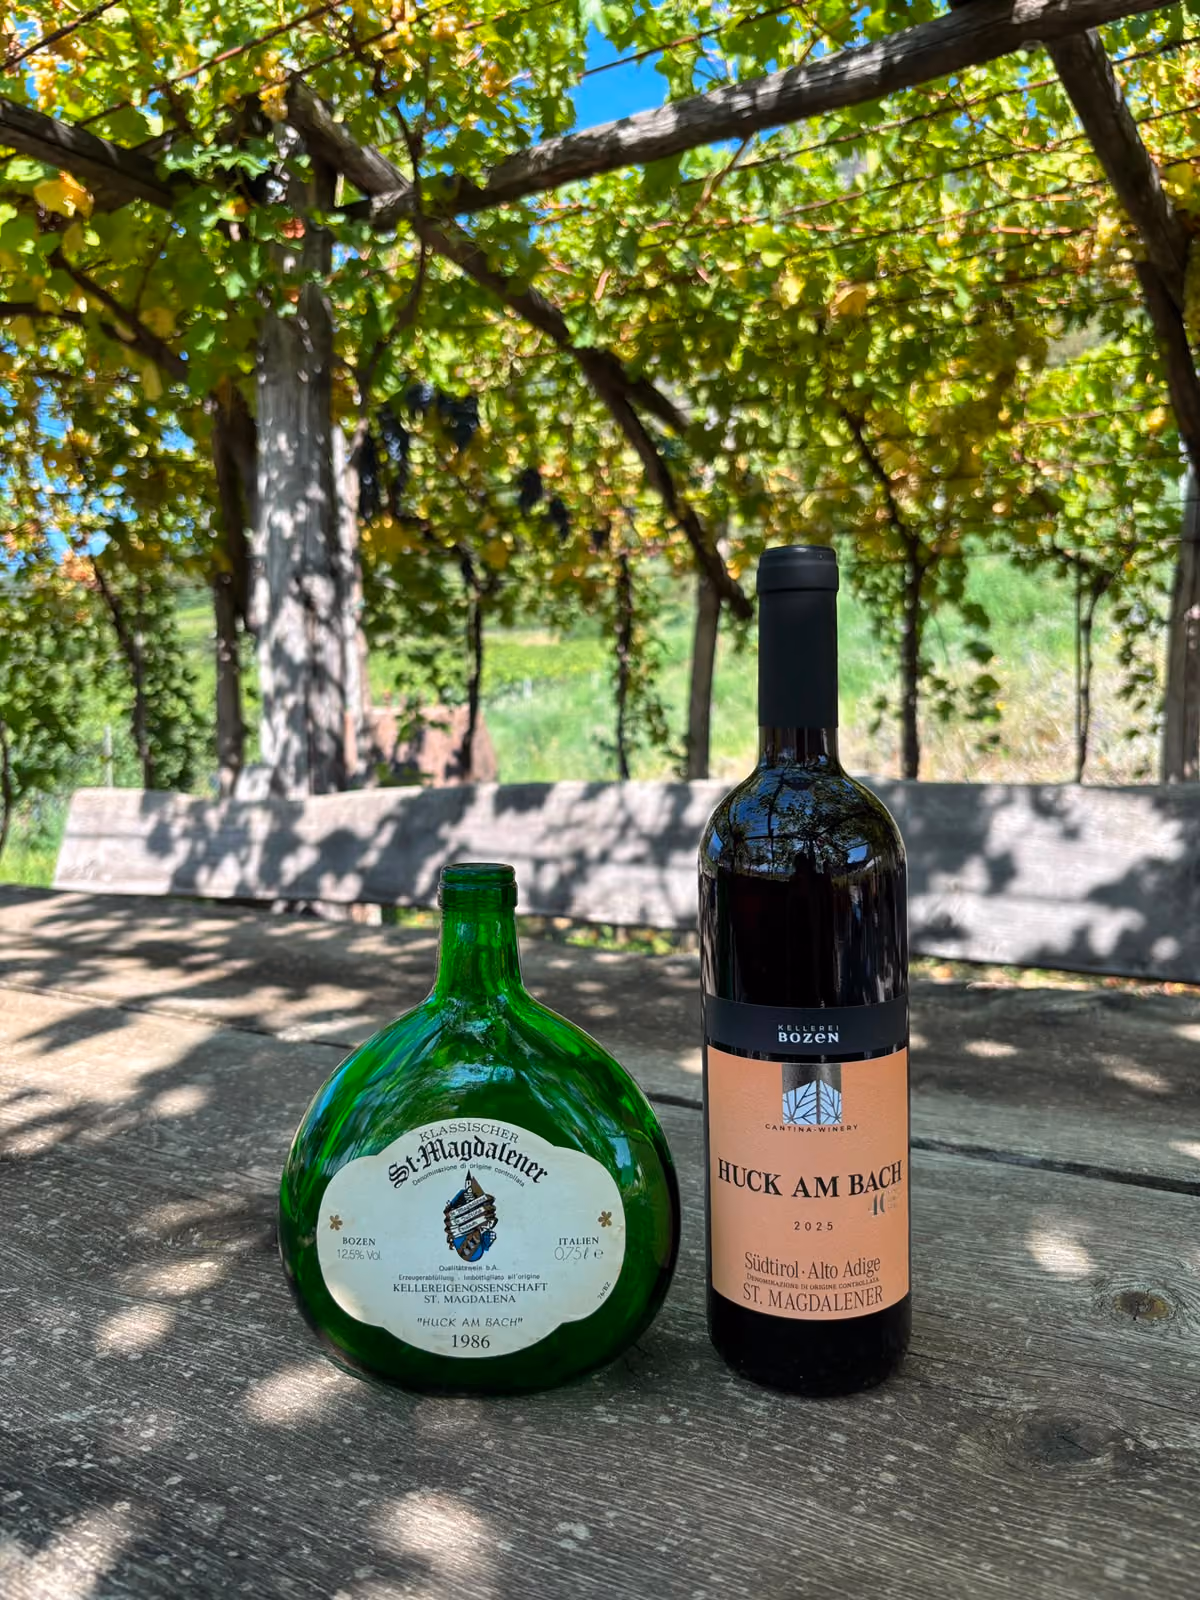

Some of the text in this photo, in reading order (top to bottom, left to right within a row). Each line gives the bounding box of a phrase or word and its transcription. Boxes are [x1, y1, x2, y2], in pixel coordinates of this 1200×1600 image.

[777, 1024, 839, 1032] KELLEREI
[419, 1123, 520, 1144] KLASSISCHER
[412, 1164, 458, 1186] Denominazione
[469, 1163, 493, 1171] origine
[494, 1166, 525, 1188] controllata
[717, 1157, 902, 1198] HUCK AM BACH
[794, 1221, 833, 1232] 2025
[342, 1236, 376, 1246] BOZEN
[558, 1236, 599, 1246] ITALIEN
[366, 1250, 383, 1261] Vol.
[744, 1251, 799, 1278] Südtirol
[807, 1261, 838, 1280] Alto
[842, 1257, 881, 1278] Adige
[393, 1282, 549, 1293] KELLEREIGENOSSENSCHAFT
[746, 1273, 799, 1290] DENOMINAZIONE
[809, 1283, 837, 1291] ORIGINE
[838, 1277, 880, 1289] CONTROLLATA
[424, 1294, 517, 1304] ST. MAGDALENA
[743, 1282, 883, 1312] ST. MAGDALENER
[417, 1317, 524, 1328] "HUCK AM BACH"
[451, 1334, 491, 1349] 1986
